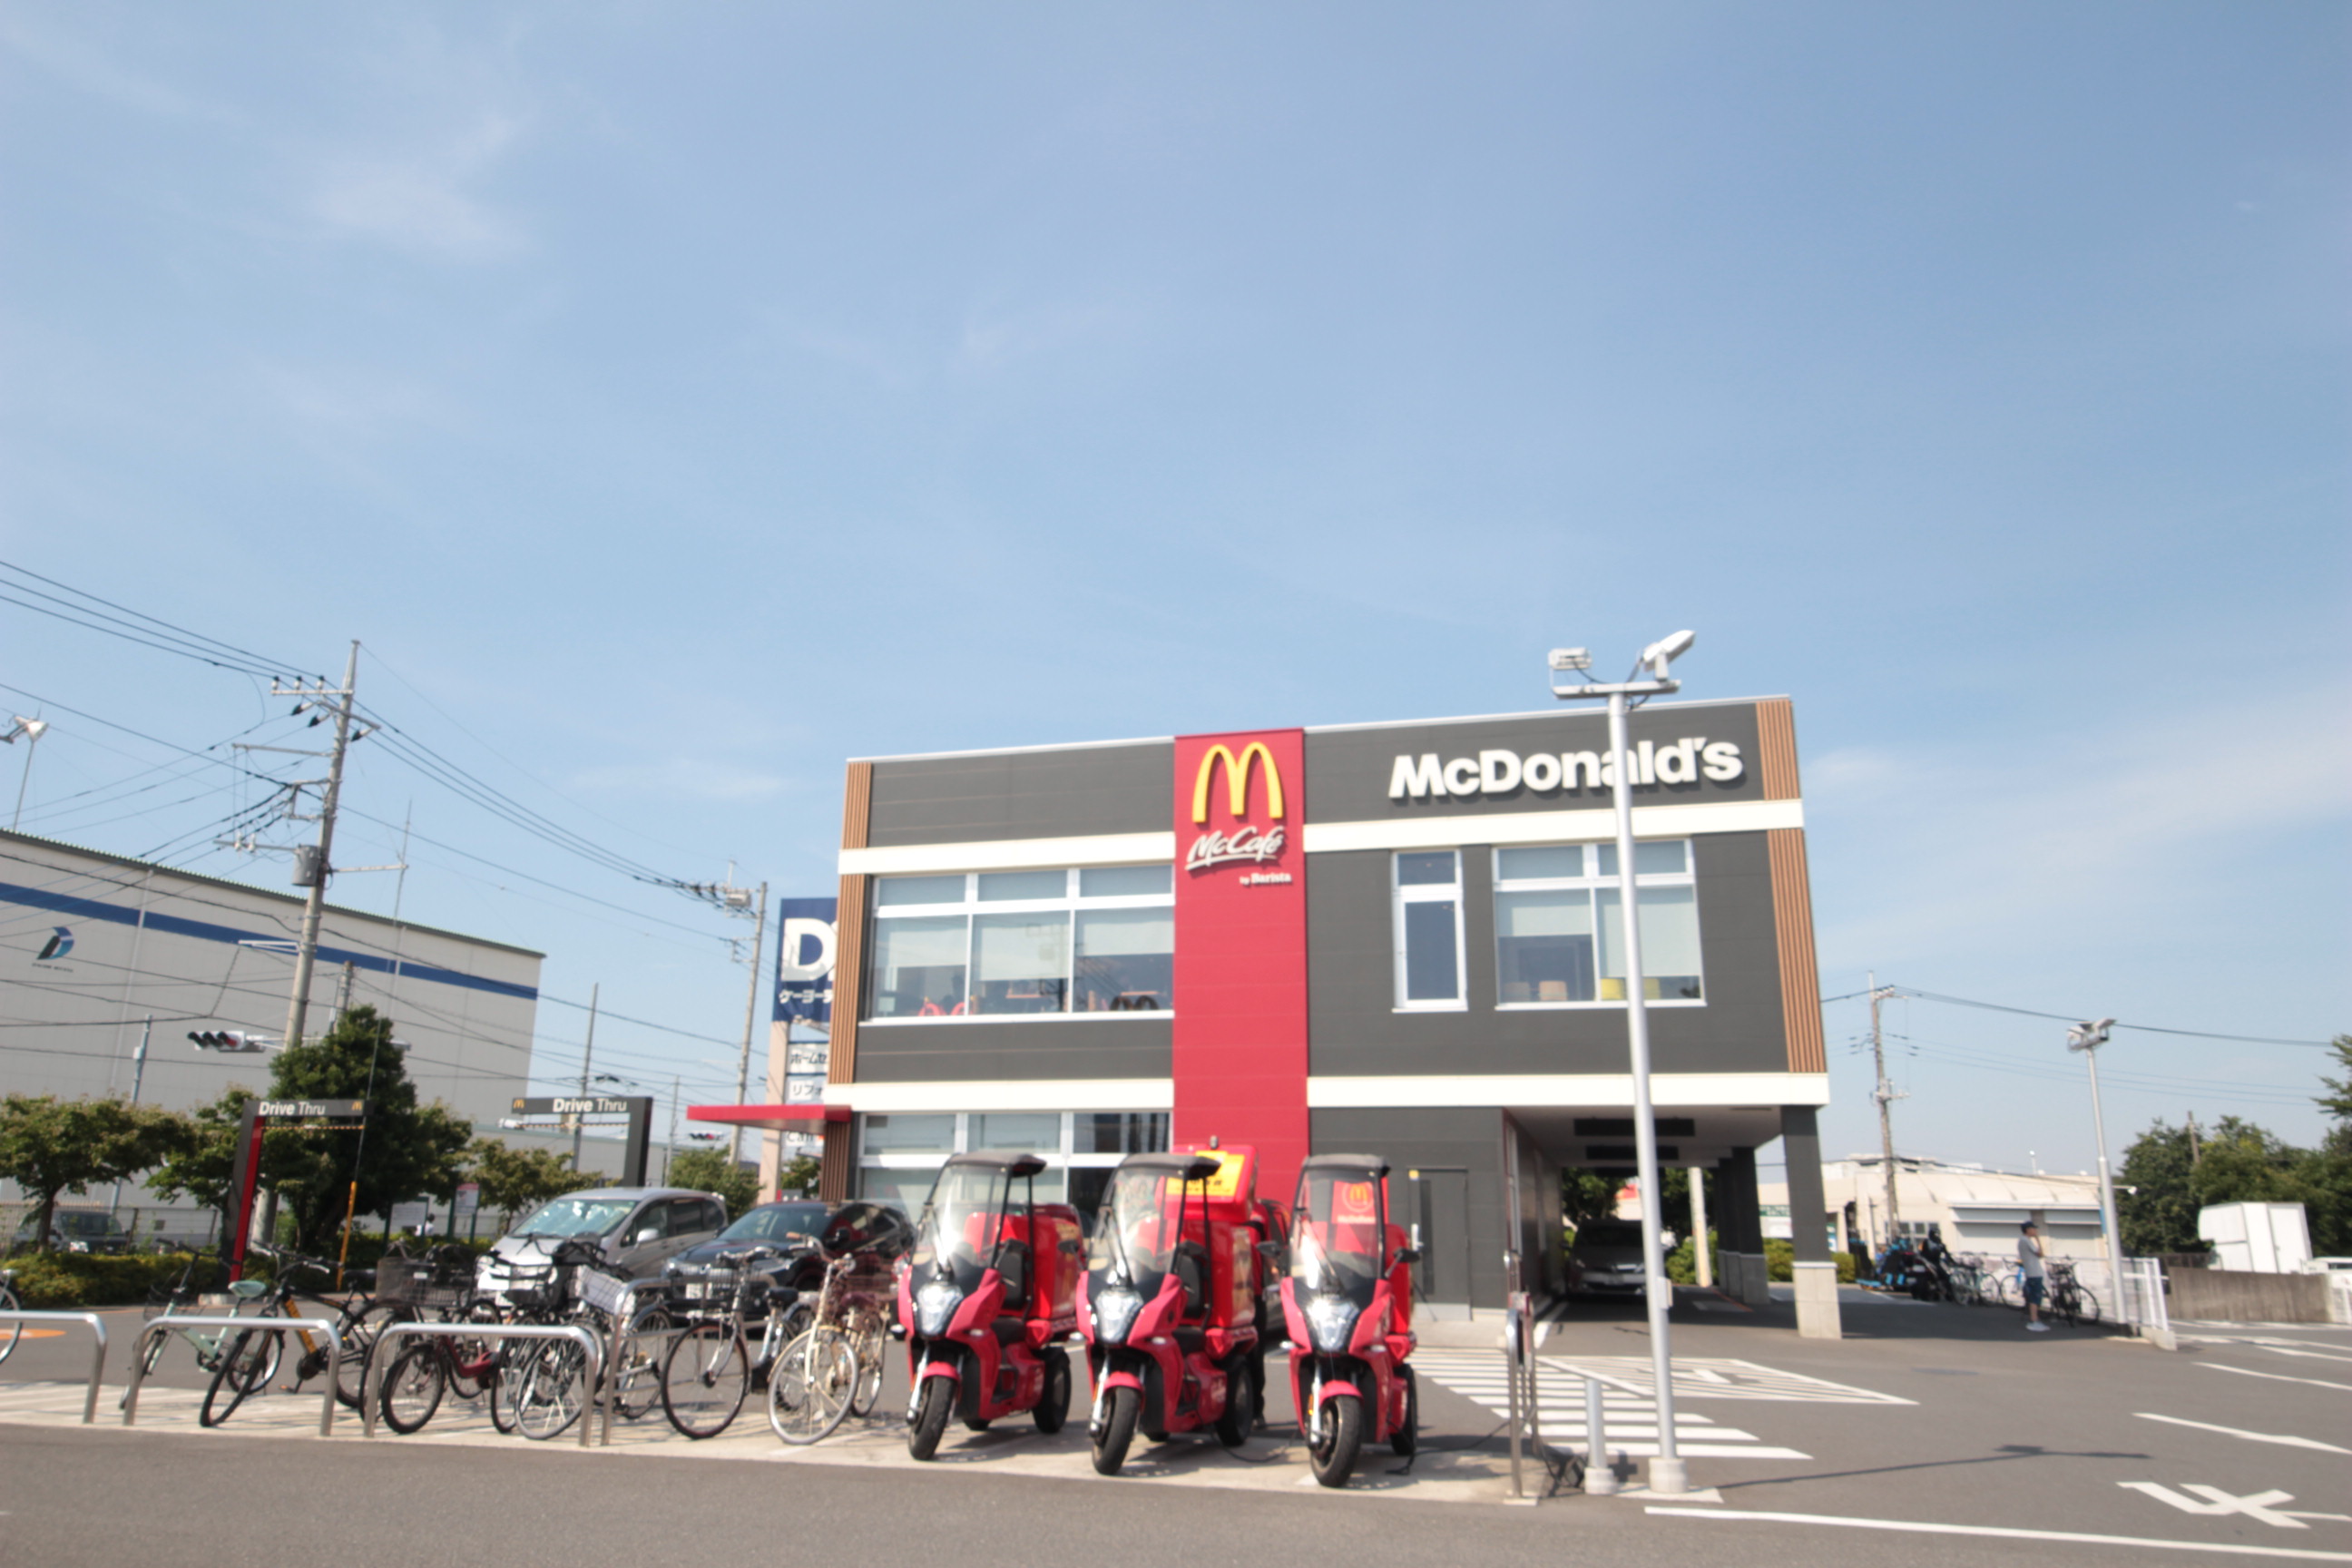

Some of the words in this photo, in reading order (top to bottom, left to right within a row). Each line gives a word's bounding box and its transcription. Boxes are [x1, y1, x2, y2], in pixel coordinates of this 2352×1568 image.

[1388, 737, 1744, 798] McDonald's
[259, 1101, 296, 1116] Drive
[298, 1101, 326, 1116] Thru
[552, 1098, 593, 1112] Drive
[596, 1098, 627, 1112] Thru
